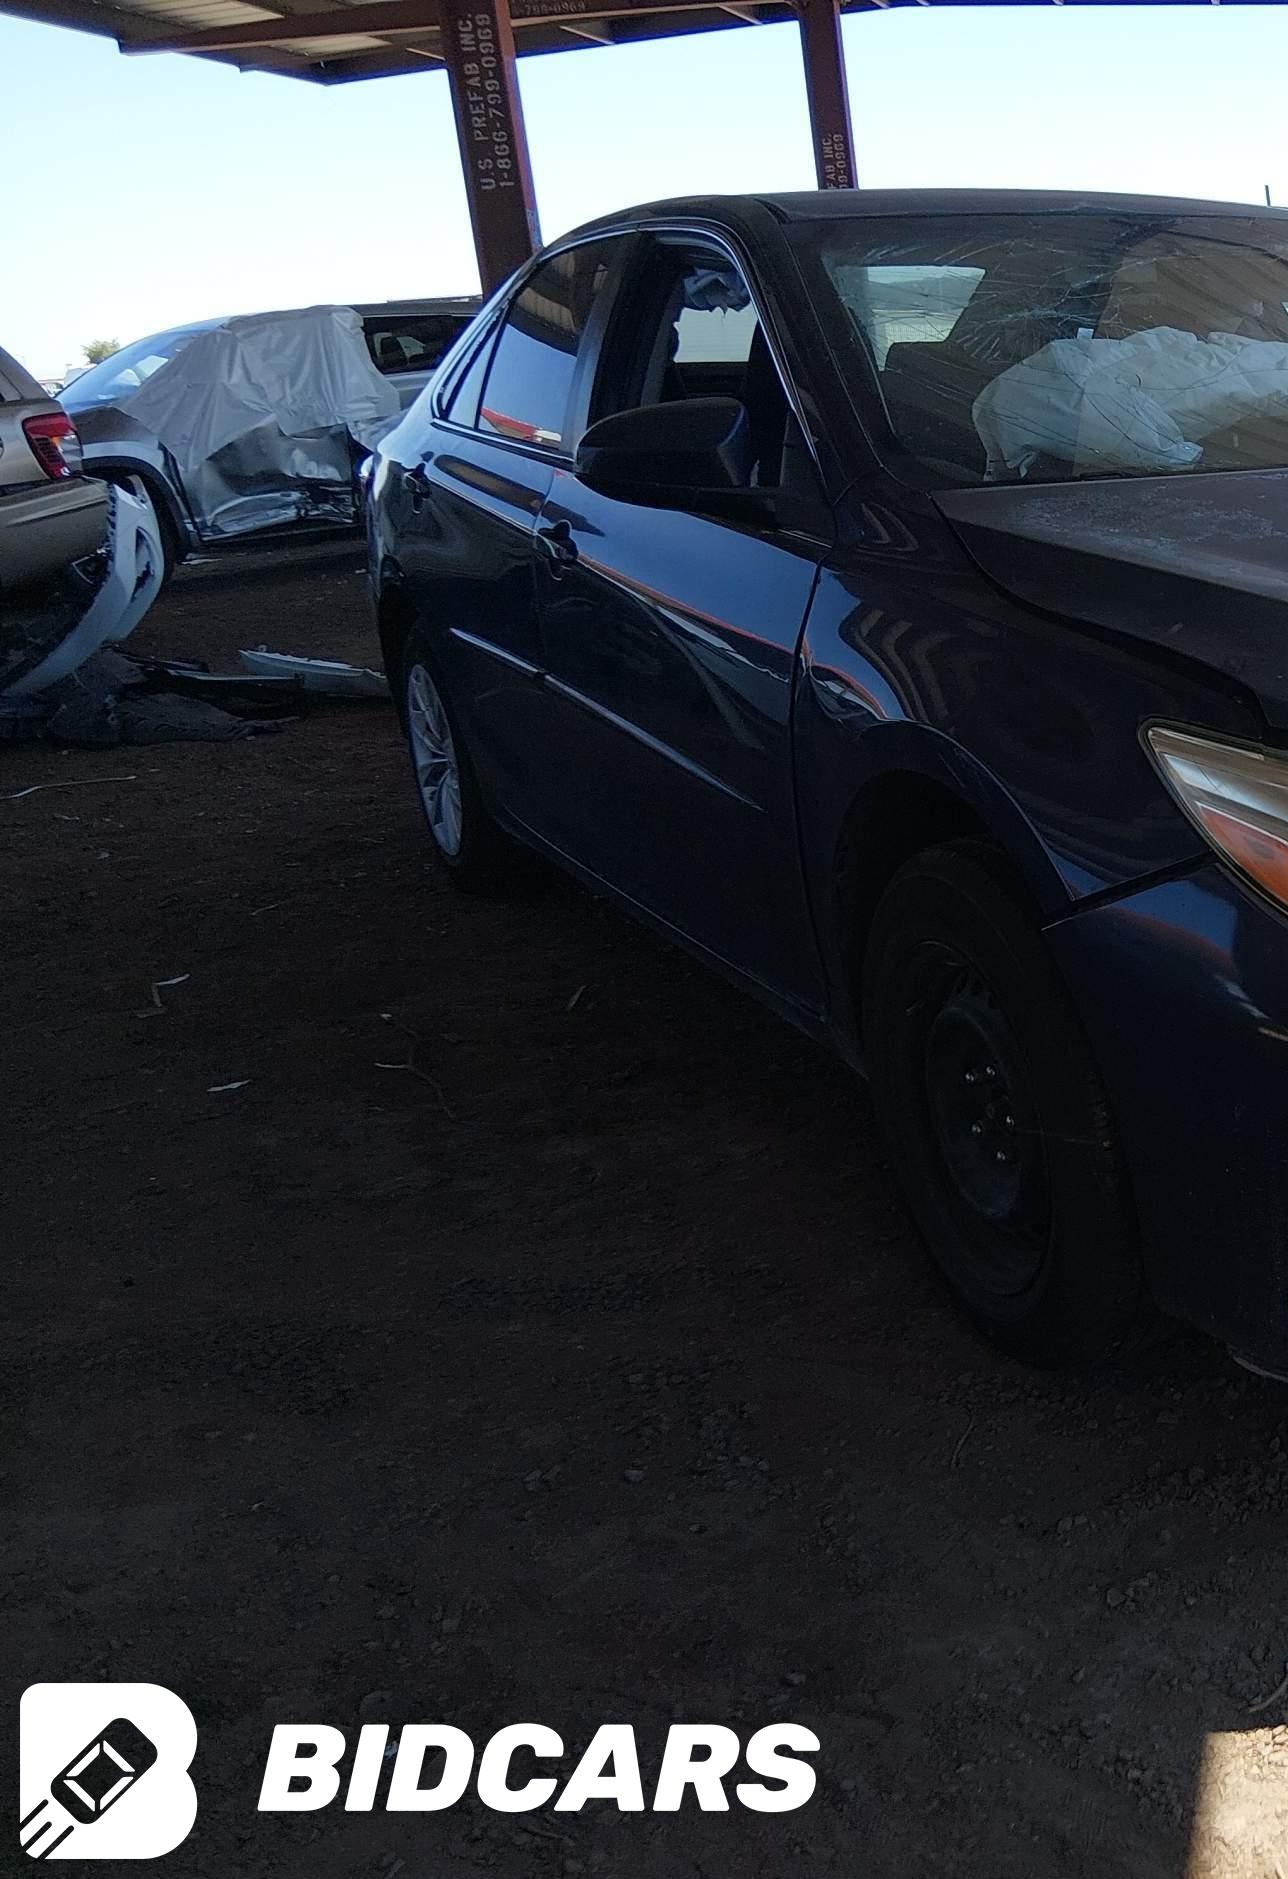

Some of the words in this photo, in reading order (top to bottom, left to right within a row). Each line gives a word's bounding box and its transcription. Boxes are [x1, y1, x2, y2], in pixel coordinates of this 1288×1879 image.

[458, 13, 477, 52] INC.
[463, 63, 489, 141] PREFAB
[475, 14, 515, 187] 1-866-799-0969
[822, 132, 834, 159] INC.
[833, 134, 849, 189] 9-0969
[825, 164, 837, 189] FAB
